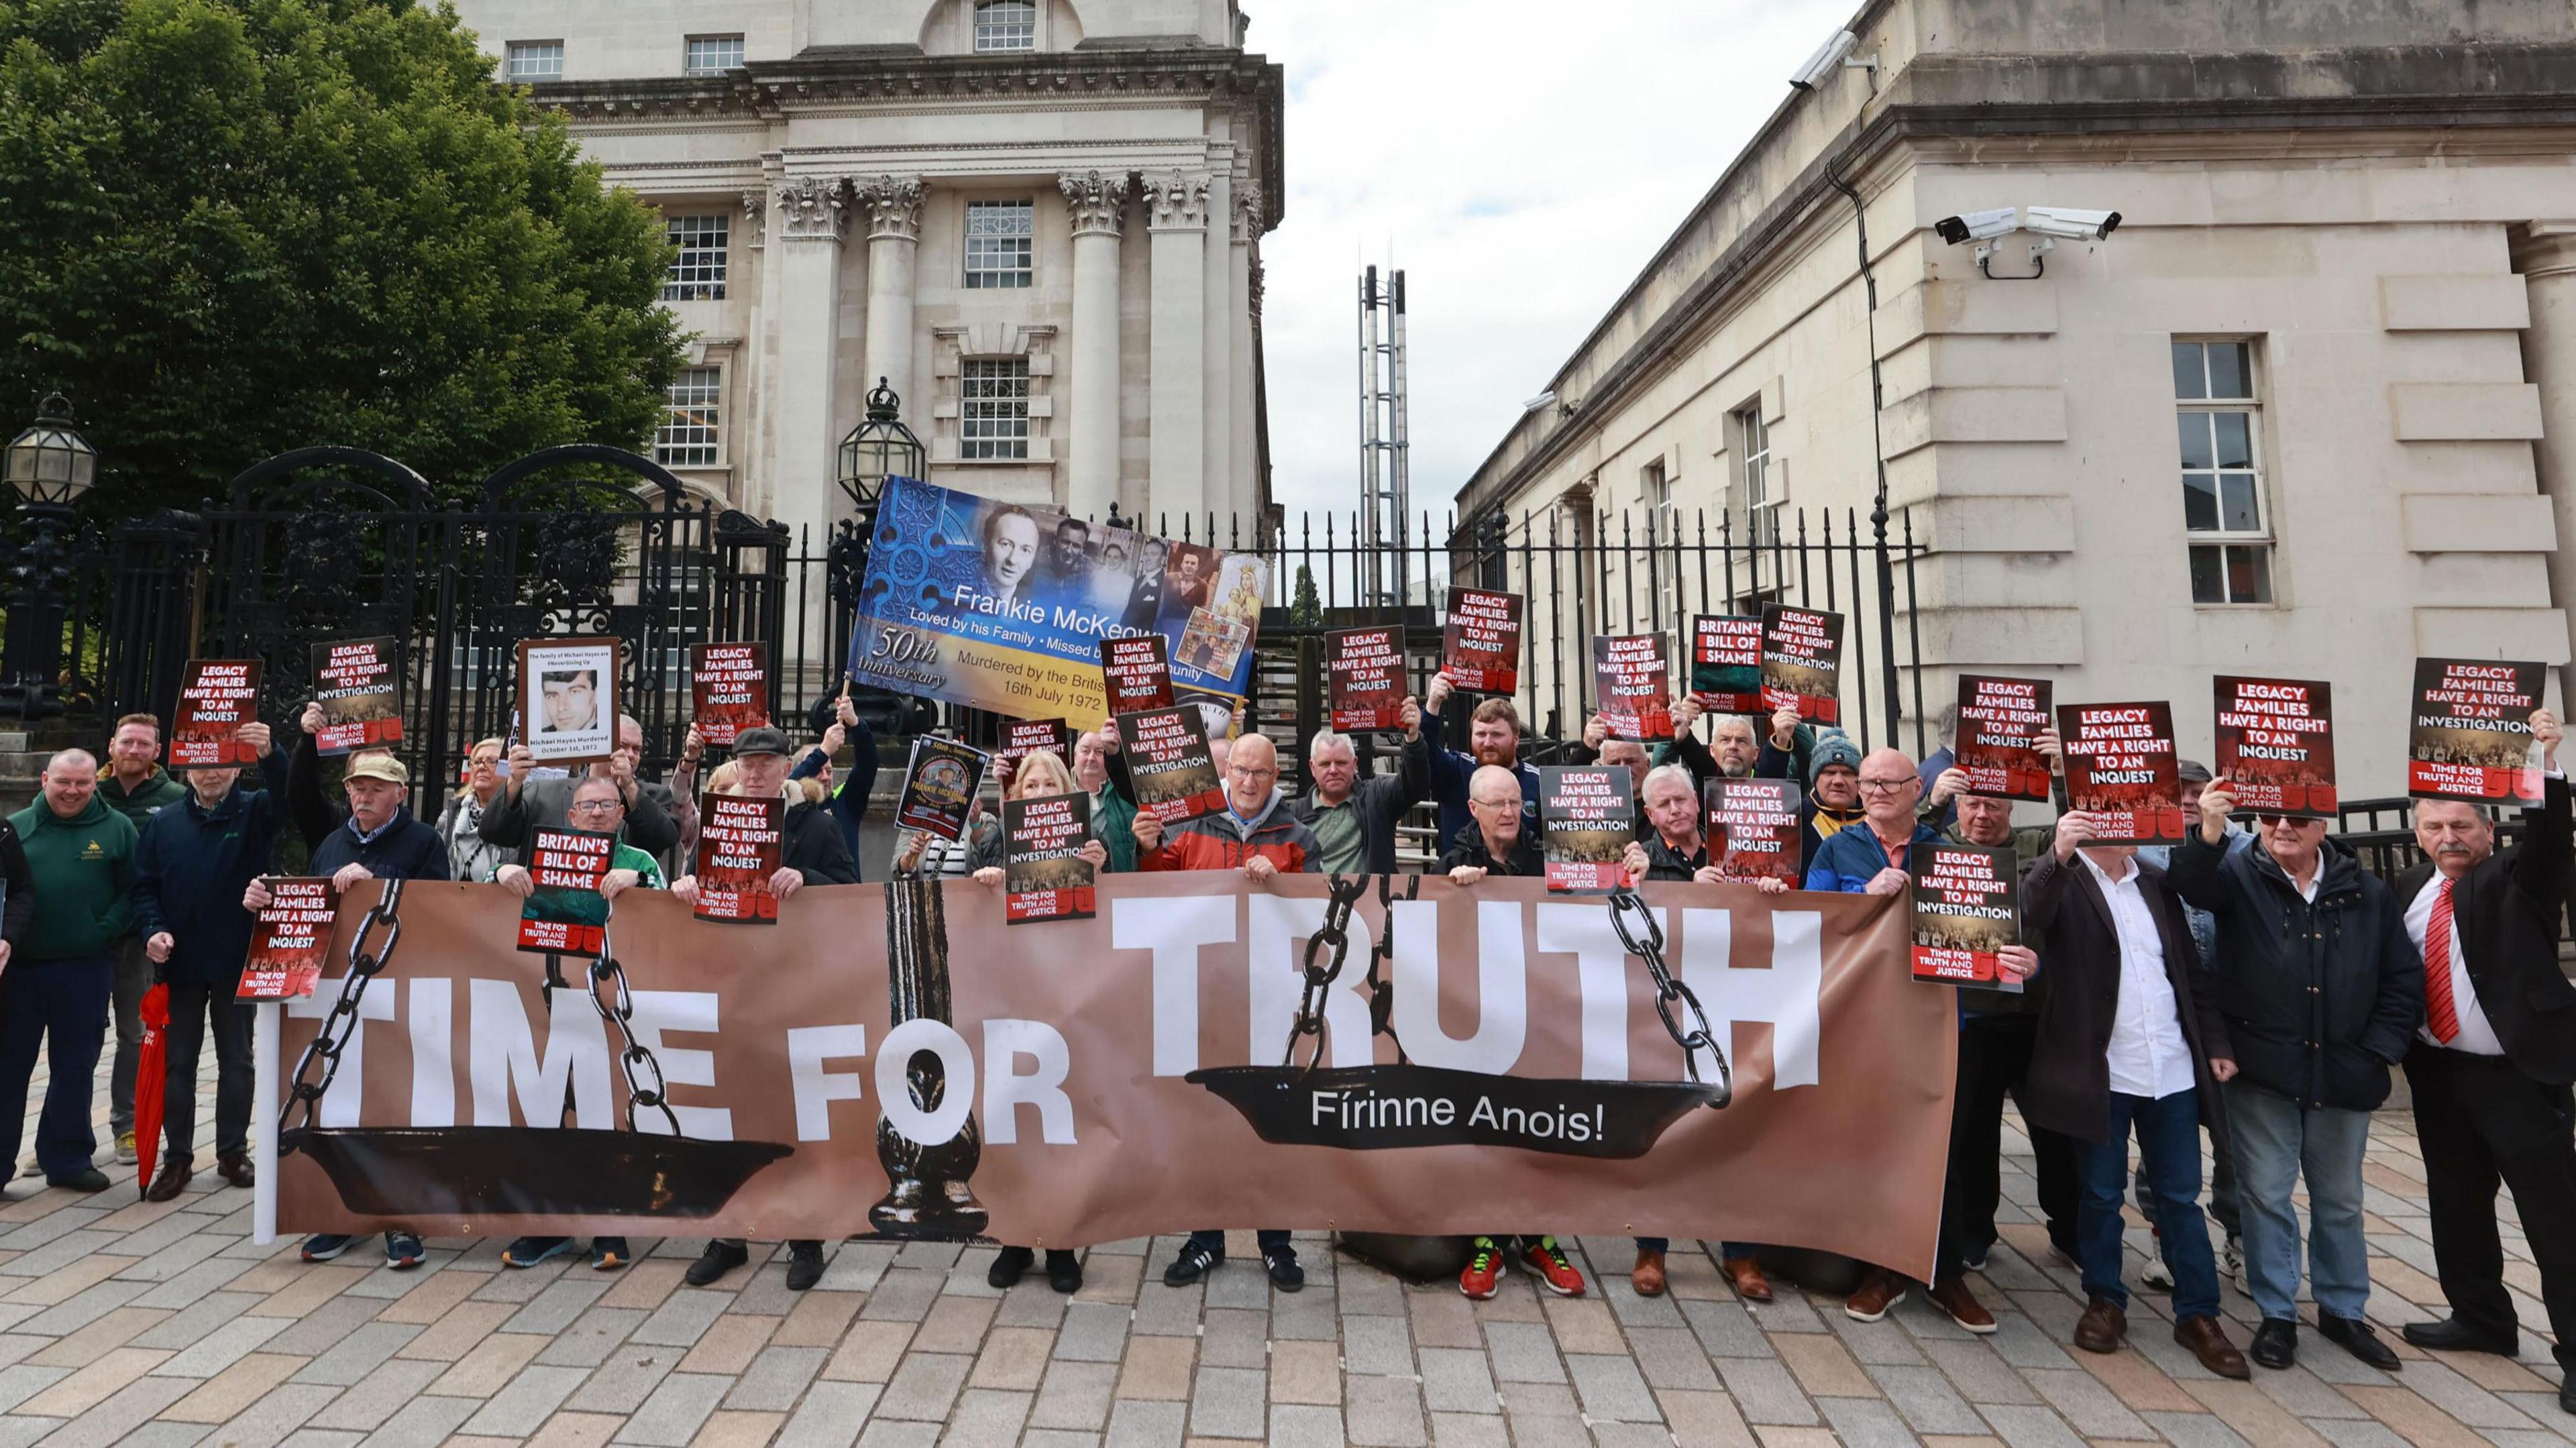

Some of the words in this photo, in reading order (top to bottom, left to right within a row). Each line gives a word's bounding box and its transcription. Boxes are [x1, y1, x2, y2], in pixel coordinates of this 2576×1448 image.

[953, 585, 1045, 624] Frankie
[1463, 593, 1508, 608] LEGACY
[1460, 604, 1509, 620] FAMILIES
[1781, 610, 1824, 626] LEGACY
[910, 608, 949, 627] Loved
[952, 620, 967, 633] by
[971, 622, 989, 634] his
[993, 626, 1035, 647] Family
[1046, 639, 1090, 657] Missed
[1778, 620, 1825, 637] FAMILIES
[872, 627, 938, 663] 50th
[1342, 632, 1387, 647] LEGACY
[1459, 638, 1503, 653] INQUEST
[1609, 638, 1653, 652] LEGACY
[1706, 634, 1735, 649] BILL
[1737, 636, 1757, 650] OF
[331, 644, 374, 657] LEGACY
[707, 648, 751, 659] LEGACY
[1114, 641, 1151, 654] LEGACY
[1342, 644, 1391, 659] FAMILIES
[330, 651, 377, 668] FAMILIES
[1114, 652, 1155, 665] FAMILIES
[1607, 649, 1656, 663] FAMILIES
[1706, 649, 1756, 665] SHAME
[1764, 651, 1835, 671] INVESTIGATION
[201, 665, 248, 676] LEGACY
[705, 659, 753, 671] FAMILIES
[957, 651, 1023, 675] Murdered
[1027, 665, 1044, 681] by
[1047, 670, 1068, 685] the
[1072, 677, 1106, 692] Britis
[2447, 665, 2514, 679] LEGACY
[197, 677, 246, 687] FAMILIES
[1346, 679, 1391, 692] INQUEST
[1979, 681, 2033, 696] LEGACY
[2443, 677, 2516, 693] FAMILIES
[318, 683, 393, 700] INVESTIGATION
[1004, 680, 1032, 697] 16th
[1036, 686, 1063, 704] July
[1069, 693, 1101, 710] 1972
[1119, 685, 1157, 698] INQUEST
[1611, 684, 1655, 696] INQUEST
[2238, 683, 2305, 700] LEGACY
[708, 693, 752, 704] INQUEST
[1976, 695, 2035, 710] FAMILIES
[2235, 698, 2309, 716] FAMILIES
[193, 711, 239, 722] INQUEST
[1136, 714, 1179, 730] LEGACY
[2082, 709, 2147, 724] LEGACY
[2220, 712, 2259, 728] HAVE
[2261, 716, 2274, 729] A
[2276, 716, 2326, 733] RIGHT
[1012, 724, 1052, 736] LEGACY
[2080, 724, 2153, 739] FAMILIES
[2418, 715, 2534, 734] INVESTIGATION
[1138, 724, 1185, 741] FAMILIES
[335, 736, 366, 746] JUSTICE
[1012, 734, 1055, 747] FAMILIES
[1976, 733, 2031, 748] INQUEST
[2239, 744, 2308, 761] INQUEST
[1132, 755, 1208, 775] INVESTIGATION
[2430, 763, 2457, 774] TIME
[2459, 766, 2483, 777] FOR
[1562, 773, 1607, 784] LEGACY
[2090, 770, 2155, 784] INQUEST
[2417, 771, 2454, 783] TRUTH
[2456, 775, 2483, 785] AND
[912, 781, 937, 794] FRANKIE
[1560, 785, 1611, 795] FAMILIES
[1725, 785, 1780, 798] LEGACY
[1974, 783, 2006, 792] JUSTICE
[2437, 783, 2483, 795] JUSTICE
[716, 800, 766, 816] LEGACY
[1025, 800, 1069, 816] LEGACY
[1723, 798, 1783, 812] FAMILIES
[2241, 799, 2283, 808] JUSTICE
[713, 814, 767, 829] FAMILIES
[1024, 812, 1073, 828] FAMILIES
[1548, 820, 1629, 832] INVESTIGATION
[537, 833, 608, 854] BRITAIN'S
[1727, 838, 1782, 852] INQUEST
[543, 852, 573, 869] BILL
[576, 855, 598, 871] OF
[712, 854, 762, 869] INQUEST
[1010, 846, 1084, 864] INVESTIGATIO
[1936, 851, 1990, 866] LEGACY
[1934, 864, 1993, 879] FAMILIES
[541, 870, 594, 889] SHAME
[1566, 879, 1598, 888] JUSTICE
[1921, 876, 1953, 889] HAVE
[1955, 879, 1966, 891] A
[1967, 880, 2007, 893] RIGHT
[276, 884, 325, 896] LEGACY
[273, 897, 325, 909] FAMILIES
[1917, 901, 2012, 920] INVESTIGATION
[260, 910, 290, 922] HAVE
[290, 911, 299, 922] A
[300, 910, 335, 922] RIGHT
[708, 907, 738, 917] JUSTICE
[1026, 906, 1057, 917] JUSTICE
[278, 924, 293, 935] TO
[294, 924, 312, 936] AN
[525, 928, 549, 938] TRUTH
[549, 932, 566, 940] AND
[534, 921, 552, 931] TIME
[552, 923, 568, 932] FOR
[268, 936, 315, 948] INQUEST
[535, 938, 566, 948] JUSTICE
[1919, 952, 1952, 967] TRUTH
[1951, 960, 1973, 969] AND
[1929, 948, 1952, 959] TIME
[1953, 950, 1972, 961] FOR
[1935, 966, 1974, 979] JUSTICE
[254, 987, 282, 996] JUSTICE
[288, 978, 733, 1141] TIME
[787, 1018, 1078, 1145] FOR
[1112, 893, 1823, 1090] TRUTH
[1312, 1090, 1455, 1129] Fírinne
[1468, 1096, 1603, 1141] Anois!
